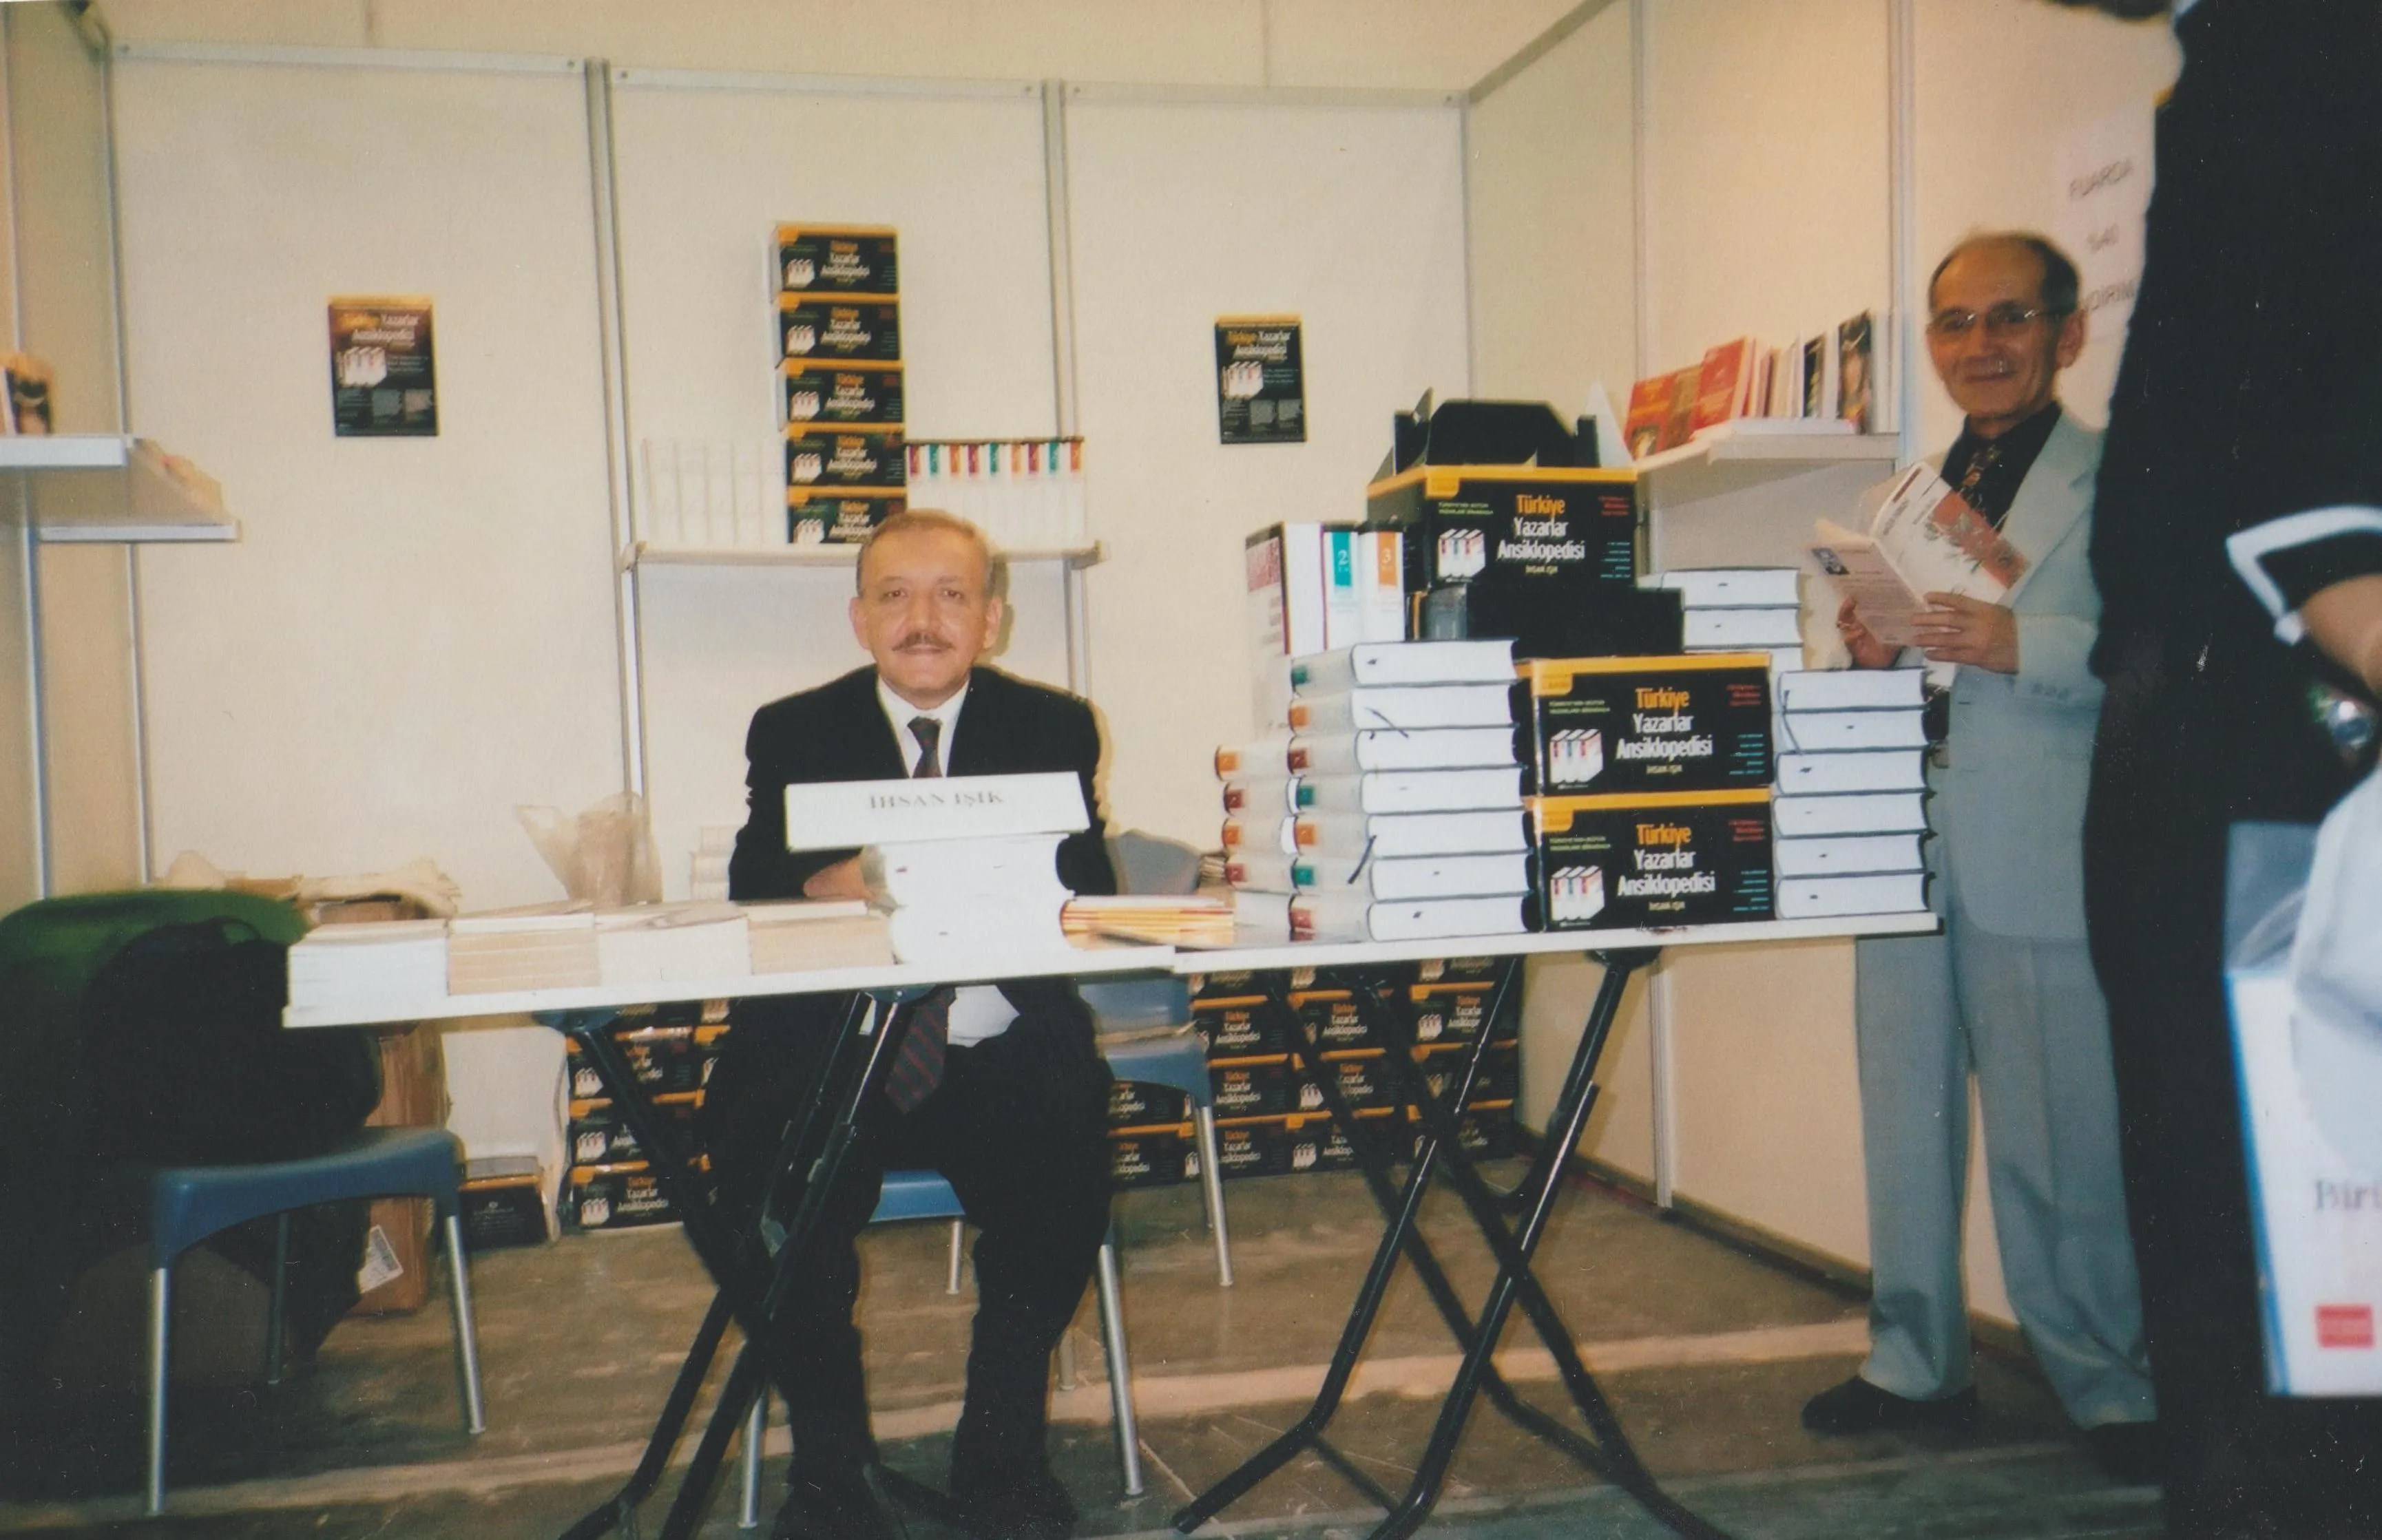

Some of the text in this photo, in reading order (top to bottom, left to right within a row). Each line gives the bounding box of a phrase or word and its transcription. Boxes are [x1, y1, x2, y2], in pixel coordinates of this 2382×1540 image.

[1516, 494, 1566, 518] Türkiye
[1513, 517, 1569, 538] Yazarlar
[1337, 549, 1349, 565] 2
[1380, 548, 1392, 565] 3
[1496, 538, 1585, 562] Ansiklopedisi
[1635, 687, 1691, 713] Türkiye
[1632, 710, 1695, 734] Yazarlar
[1616, 734, 1713, 761] Ansiklopedisi
[1636, 823, 1692, 847] Türkiye
[1633, 847, 1697, 871] Yazarlar
[1617, 870, 1716, 898] Ansiklopedisi
